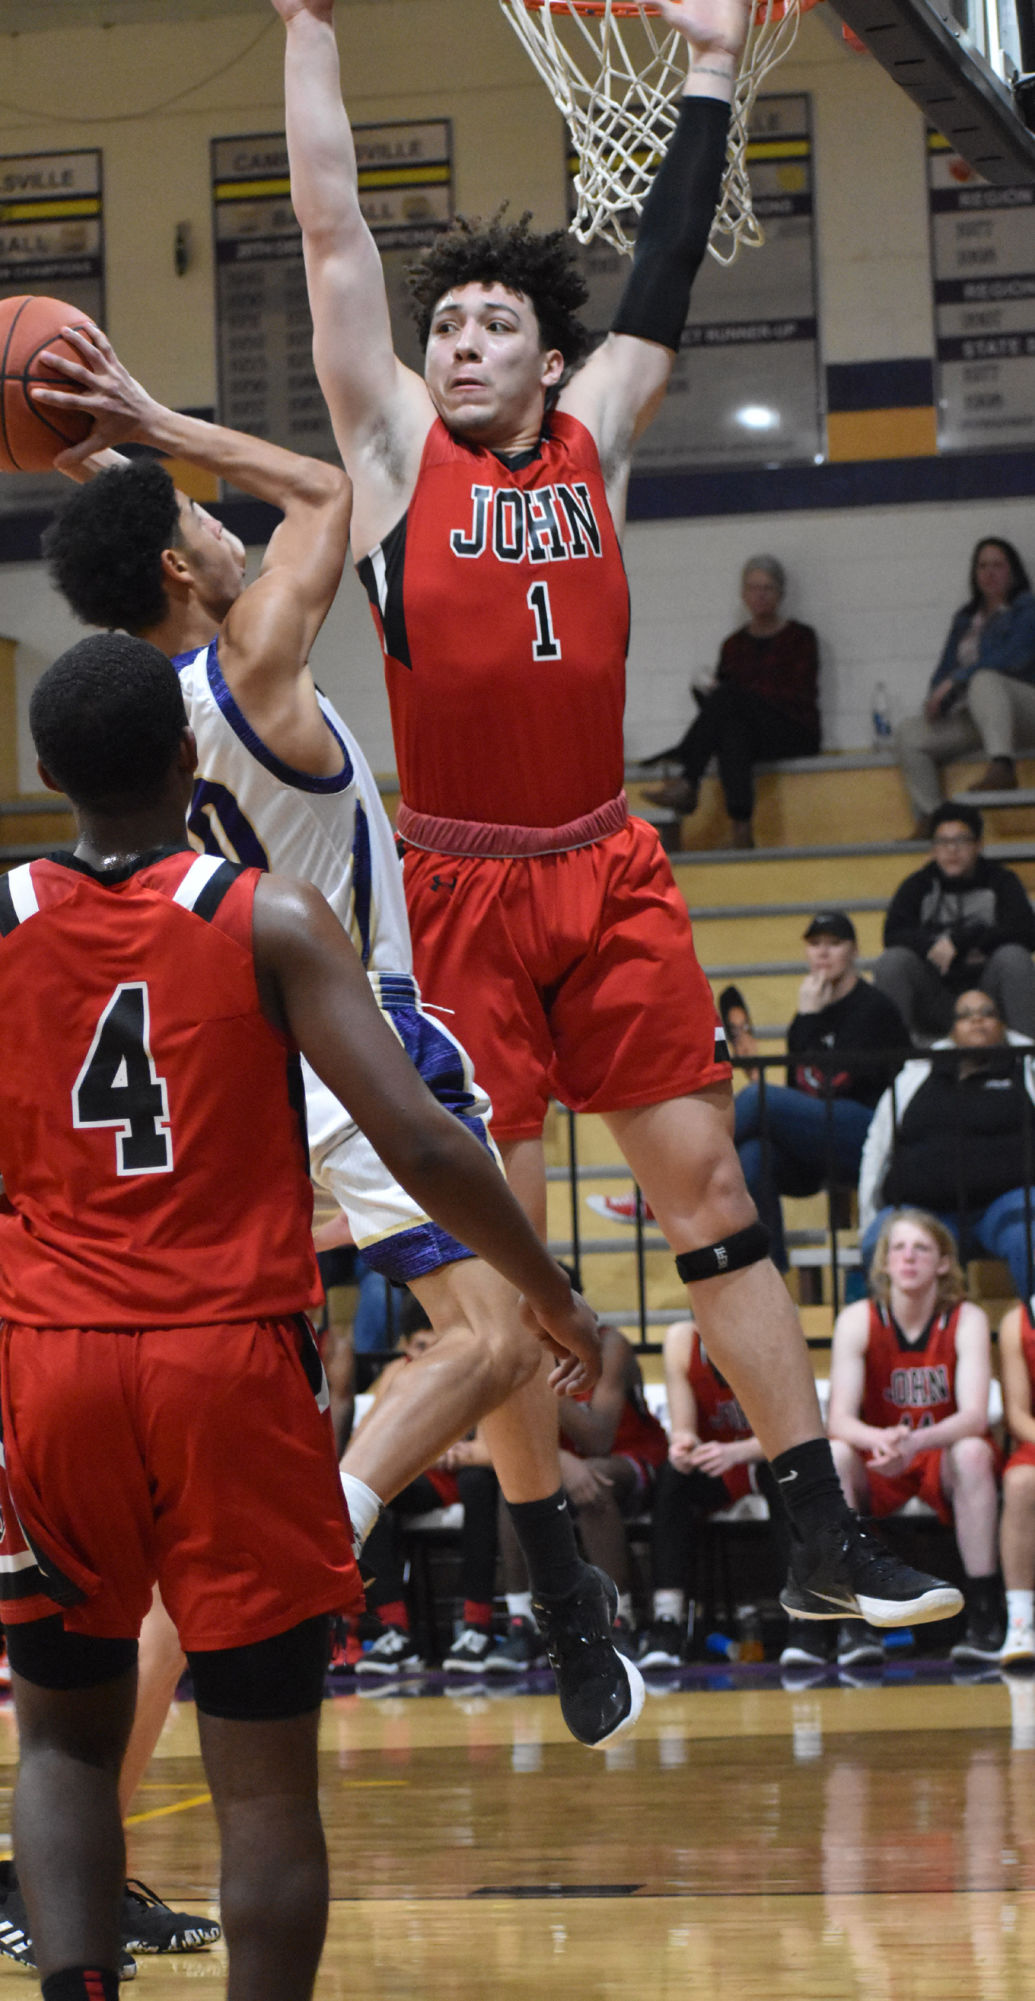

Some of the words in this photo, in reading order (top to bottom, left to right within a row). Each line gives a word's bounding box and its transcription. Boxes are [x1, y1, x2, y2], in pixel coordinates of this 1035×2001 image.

[450, 483, 602, 564] JOHN
[526, 580, 562, 662] 1
[71, 981, 174, 1176] 4
